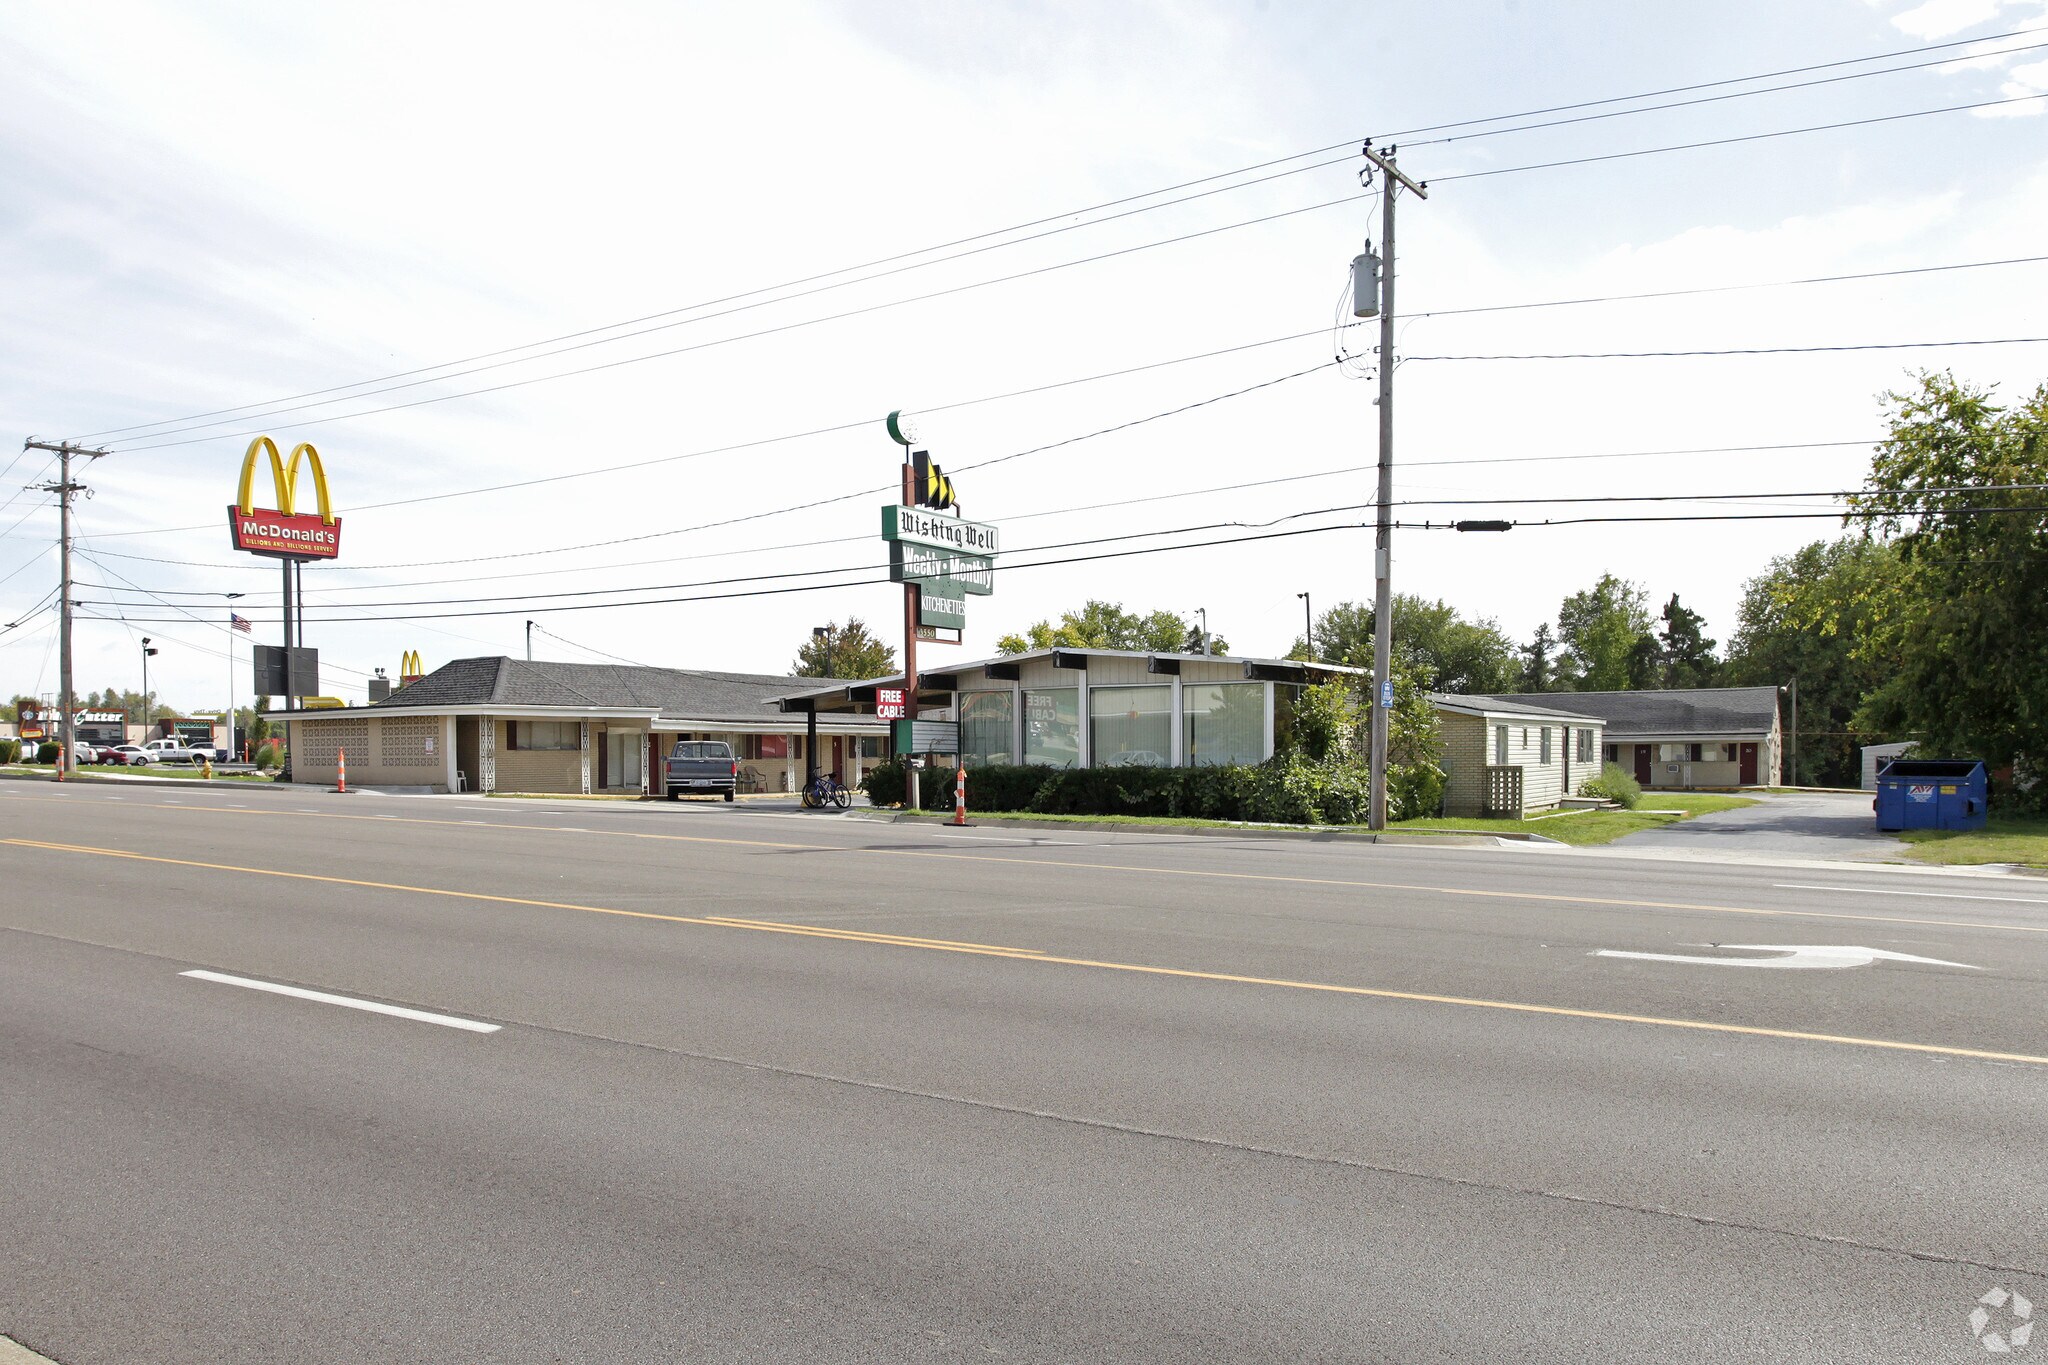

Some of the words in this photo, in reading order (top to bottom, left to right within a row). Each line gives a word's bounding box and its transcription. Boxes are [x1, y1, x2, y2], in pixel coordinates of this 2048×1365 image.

[242, 522, 335, 544] McDonald's
[901, 511, 963, 548] Wishing
[965, 525, 995, 550] Well
[245, 538, 271, 548] BILLIONS
[286, 542, 312, 551] BILLIONS
[313, 544, 334, 553] SERVED
[903, 546, 942, 580] Weekly
[949, 553, 993, 590] Monthly
[921, 595, 966, 616] KITCHENETTES
[880, 689, 902, 703] FREE
[877, 704, 905, 718] CABLE
